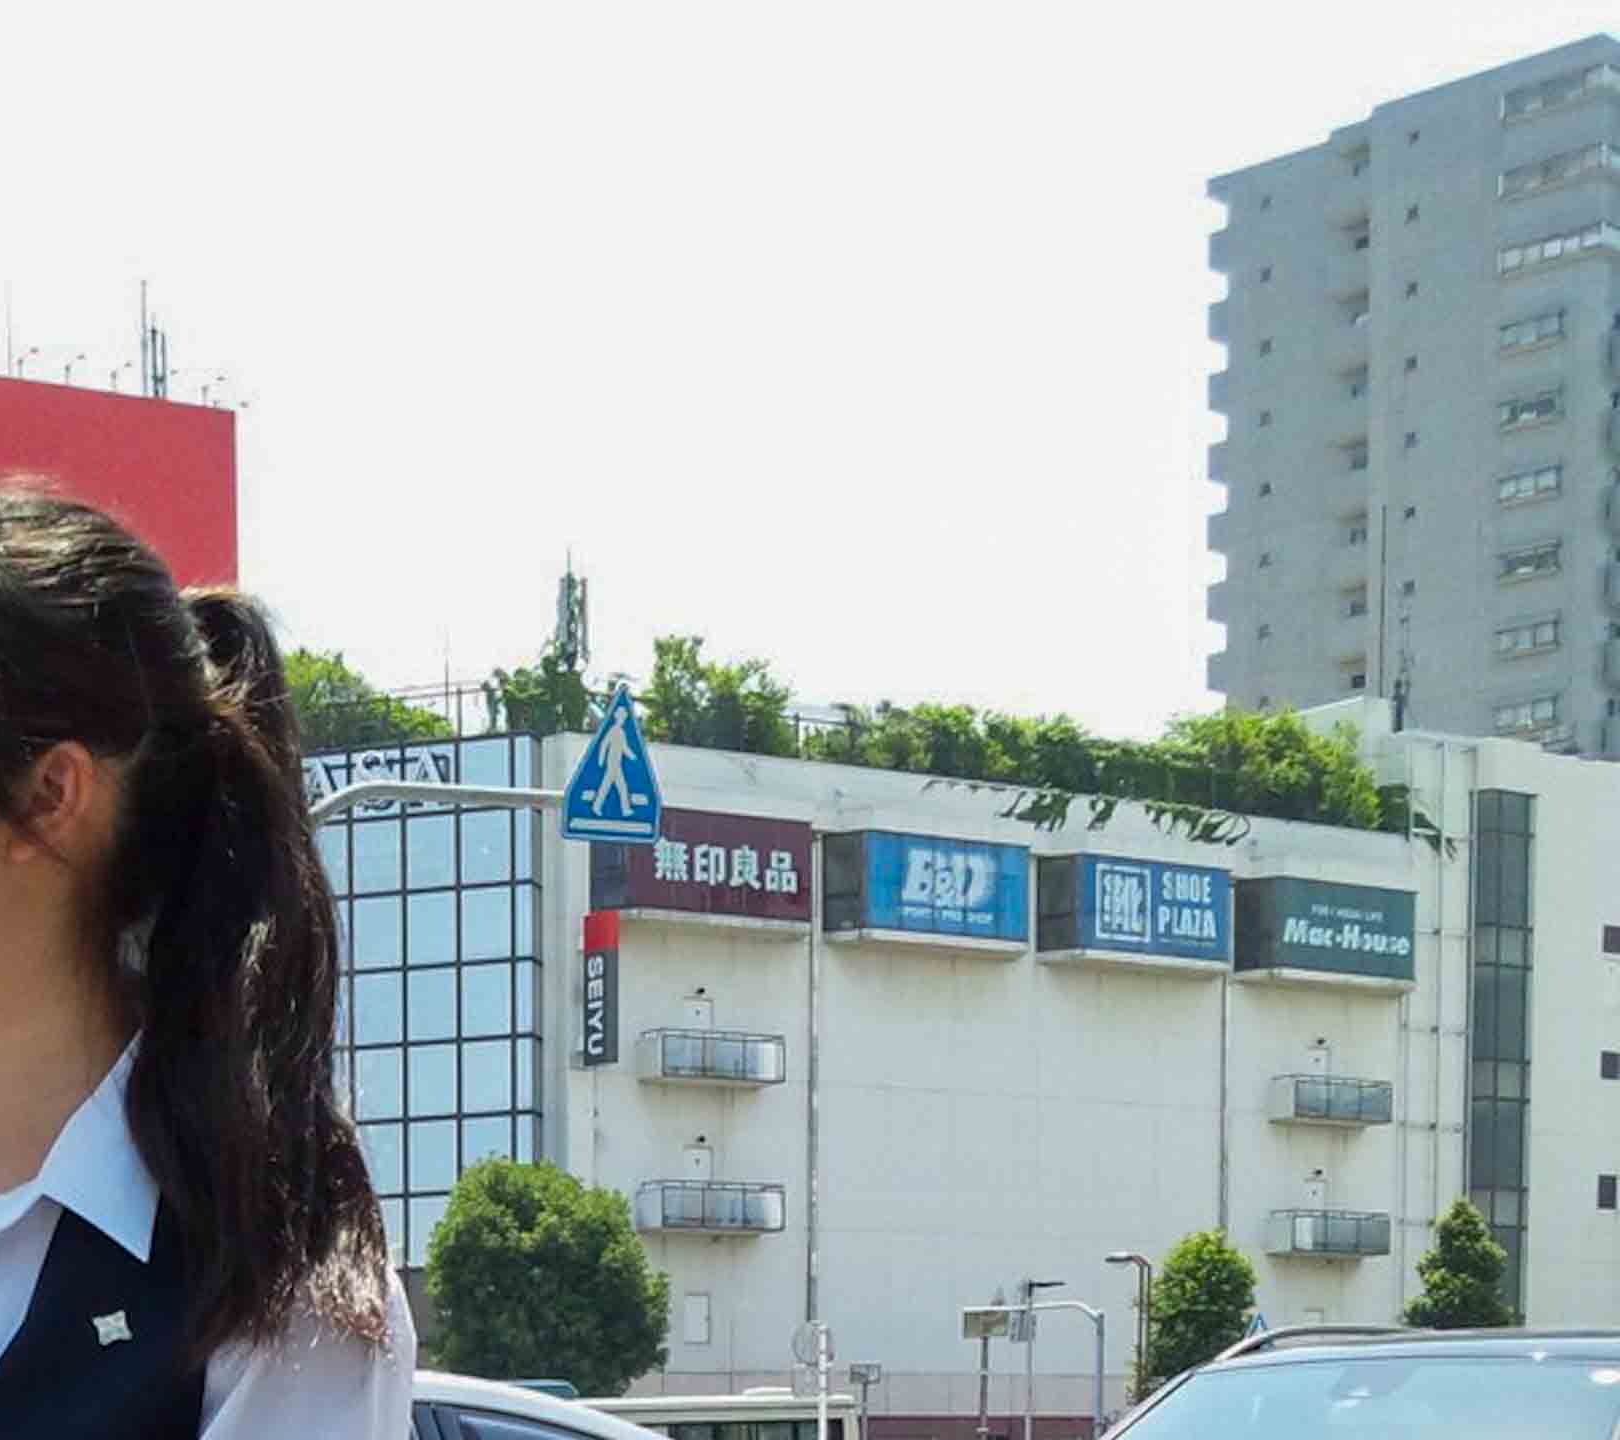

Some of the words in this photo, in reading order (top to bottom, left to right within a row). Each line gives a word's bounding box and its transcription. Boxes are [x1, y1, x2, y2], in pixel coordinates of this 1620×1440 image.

[654, 837, 799, 894] 無印良品
[1162, 871, 1213, 904] SHOE
[1156, 905, 1217, 939] PLAZA
[587, 955, 604, 1056] SEIYU
